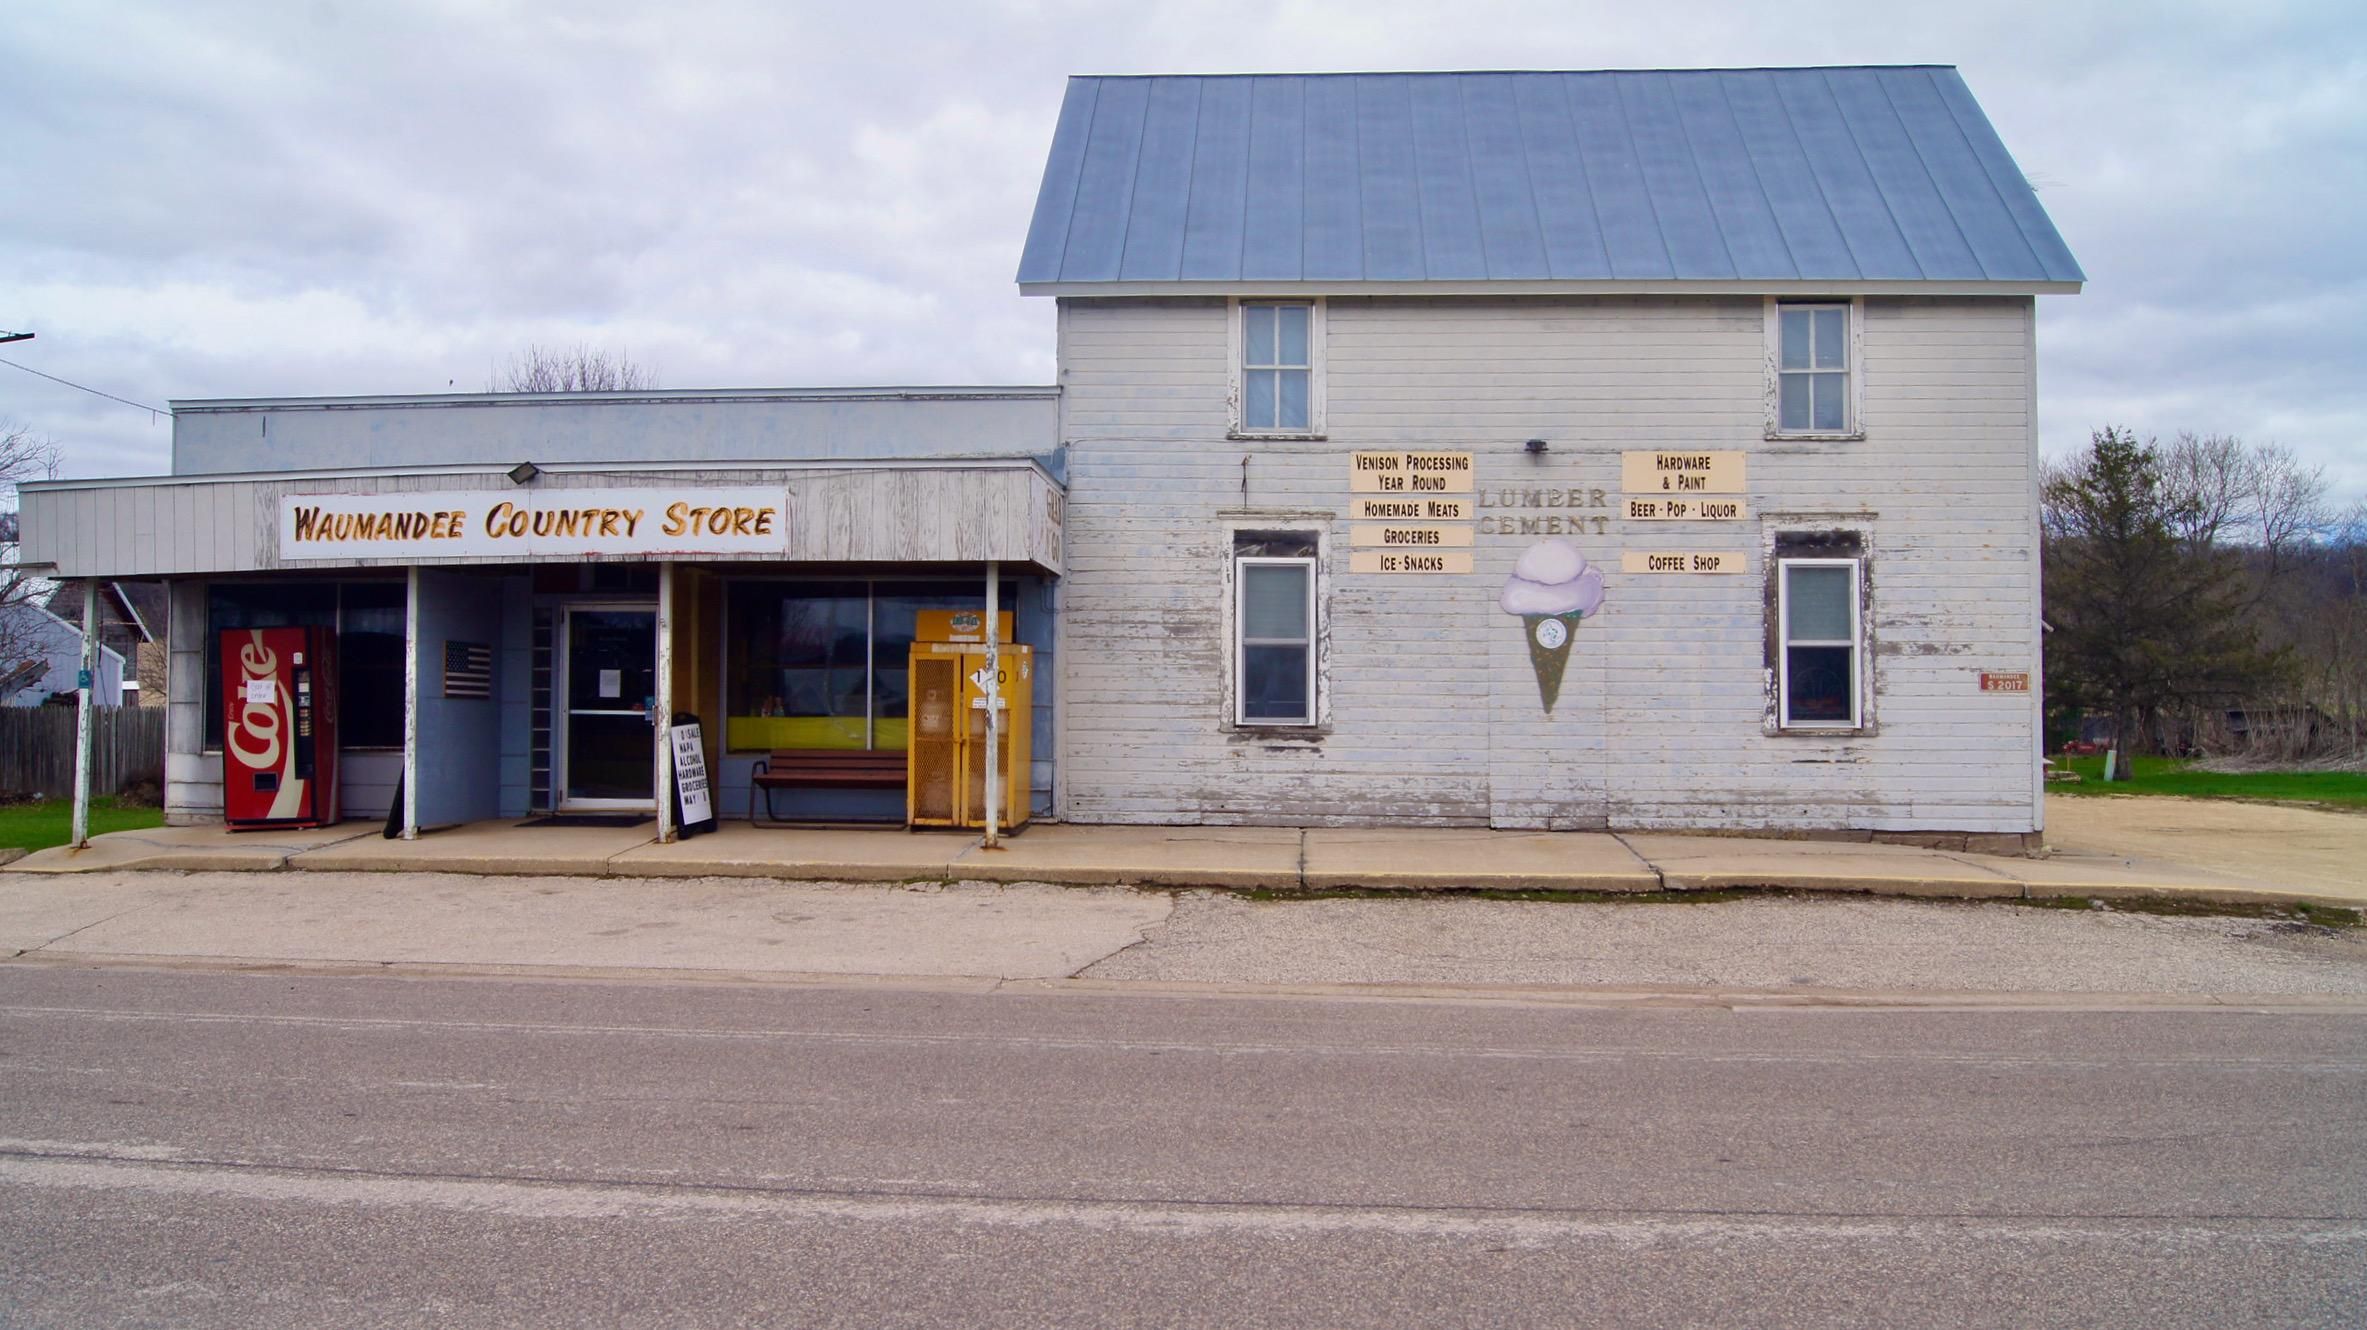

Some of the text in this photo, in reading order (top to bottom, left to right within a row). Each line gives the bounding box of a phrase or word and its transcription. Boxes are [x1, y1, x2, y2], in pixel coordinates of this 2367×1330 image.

[1356, 454, 1468, 470] VENISON PROCESSING
[1657, 454, 1711, 470] HARDWARE
[1378, 474, 1446, 490] YEAR ROUND
[1662, 474, 1706, 490] & PAINT
[1479, 488, 1607, 508] LUMBER
[1364, 501, 1459, 517] HOMEMADE MEATS
[1630, 501, 1737, 519] BEER POP LIQUOR
[294, 501, 776, 543] WAUMANDEE COUNTRY STORE
[1481, 516, 1609, 535] CEMENT
[1384, 528, 1440, 544] GROCERIES
[1648, 555, 1720, 571] COFFEE SHOP
[1997, 680, 2023, 690] 2017
